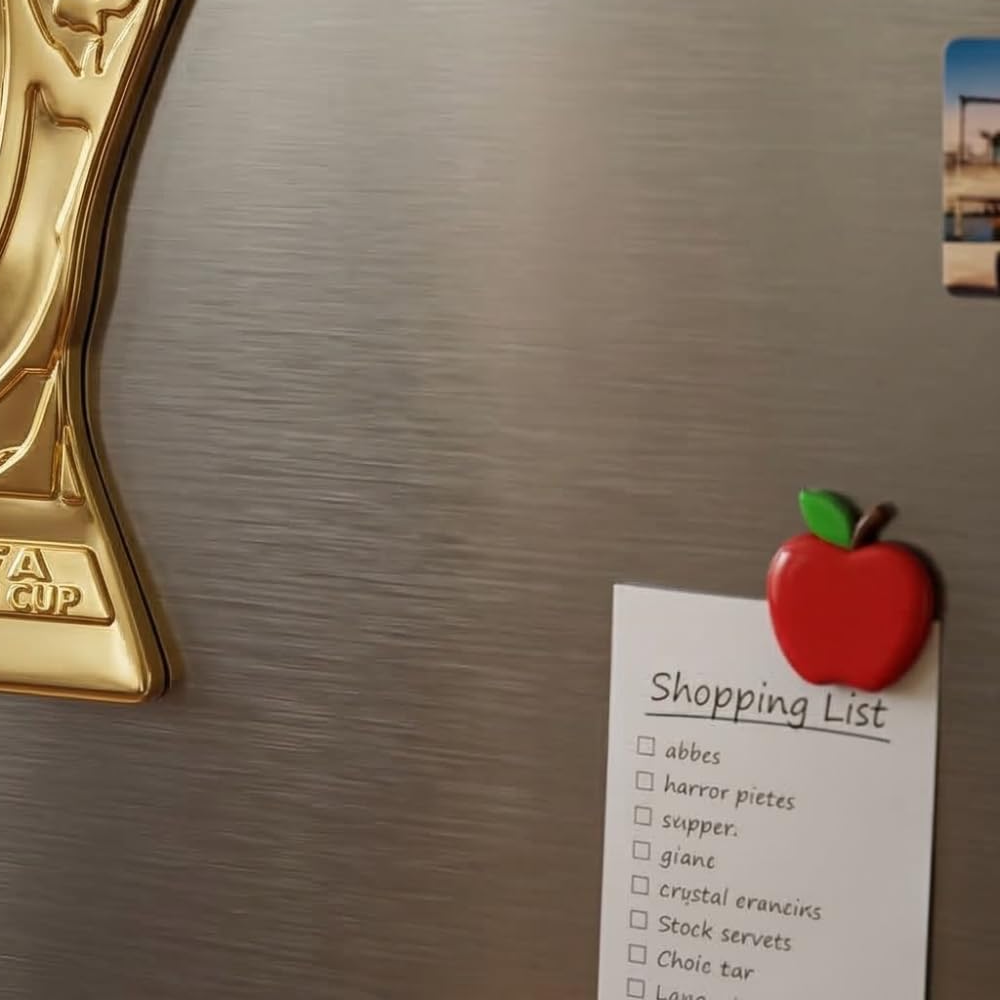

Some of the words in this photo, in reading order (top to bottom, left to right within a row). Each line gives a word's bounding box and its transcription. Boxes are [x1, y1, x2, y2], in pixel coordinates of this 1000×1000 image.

[6, 582, 82, 615] CUP
[650, 671, 809, 729] Shopping
[823, 691, 890, 729] List
[664, 740, 721, 765] abbes
[664, 773, 730, 800] harror
[657, 914, 713, 940] Stock
[719, 960, 756, 981] tar
